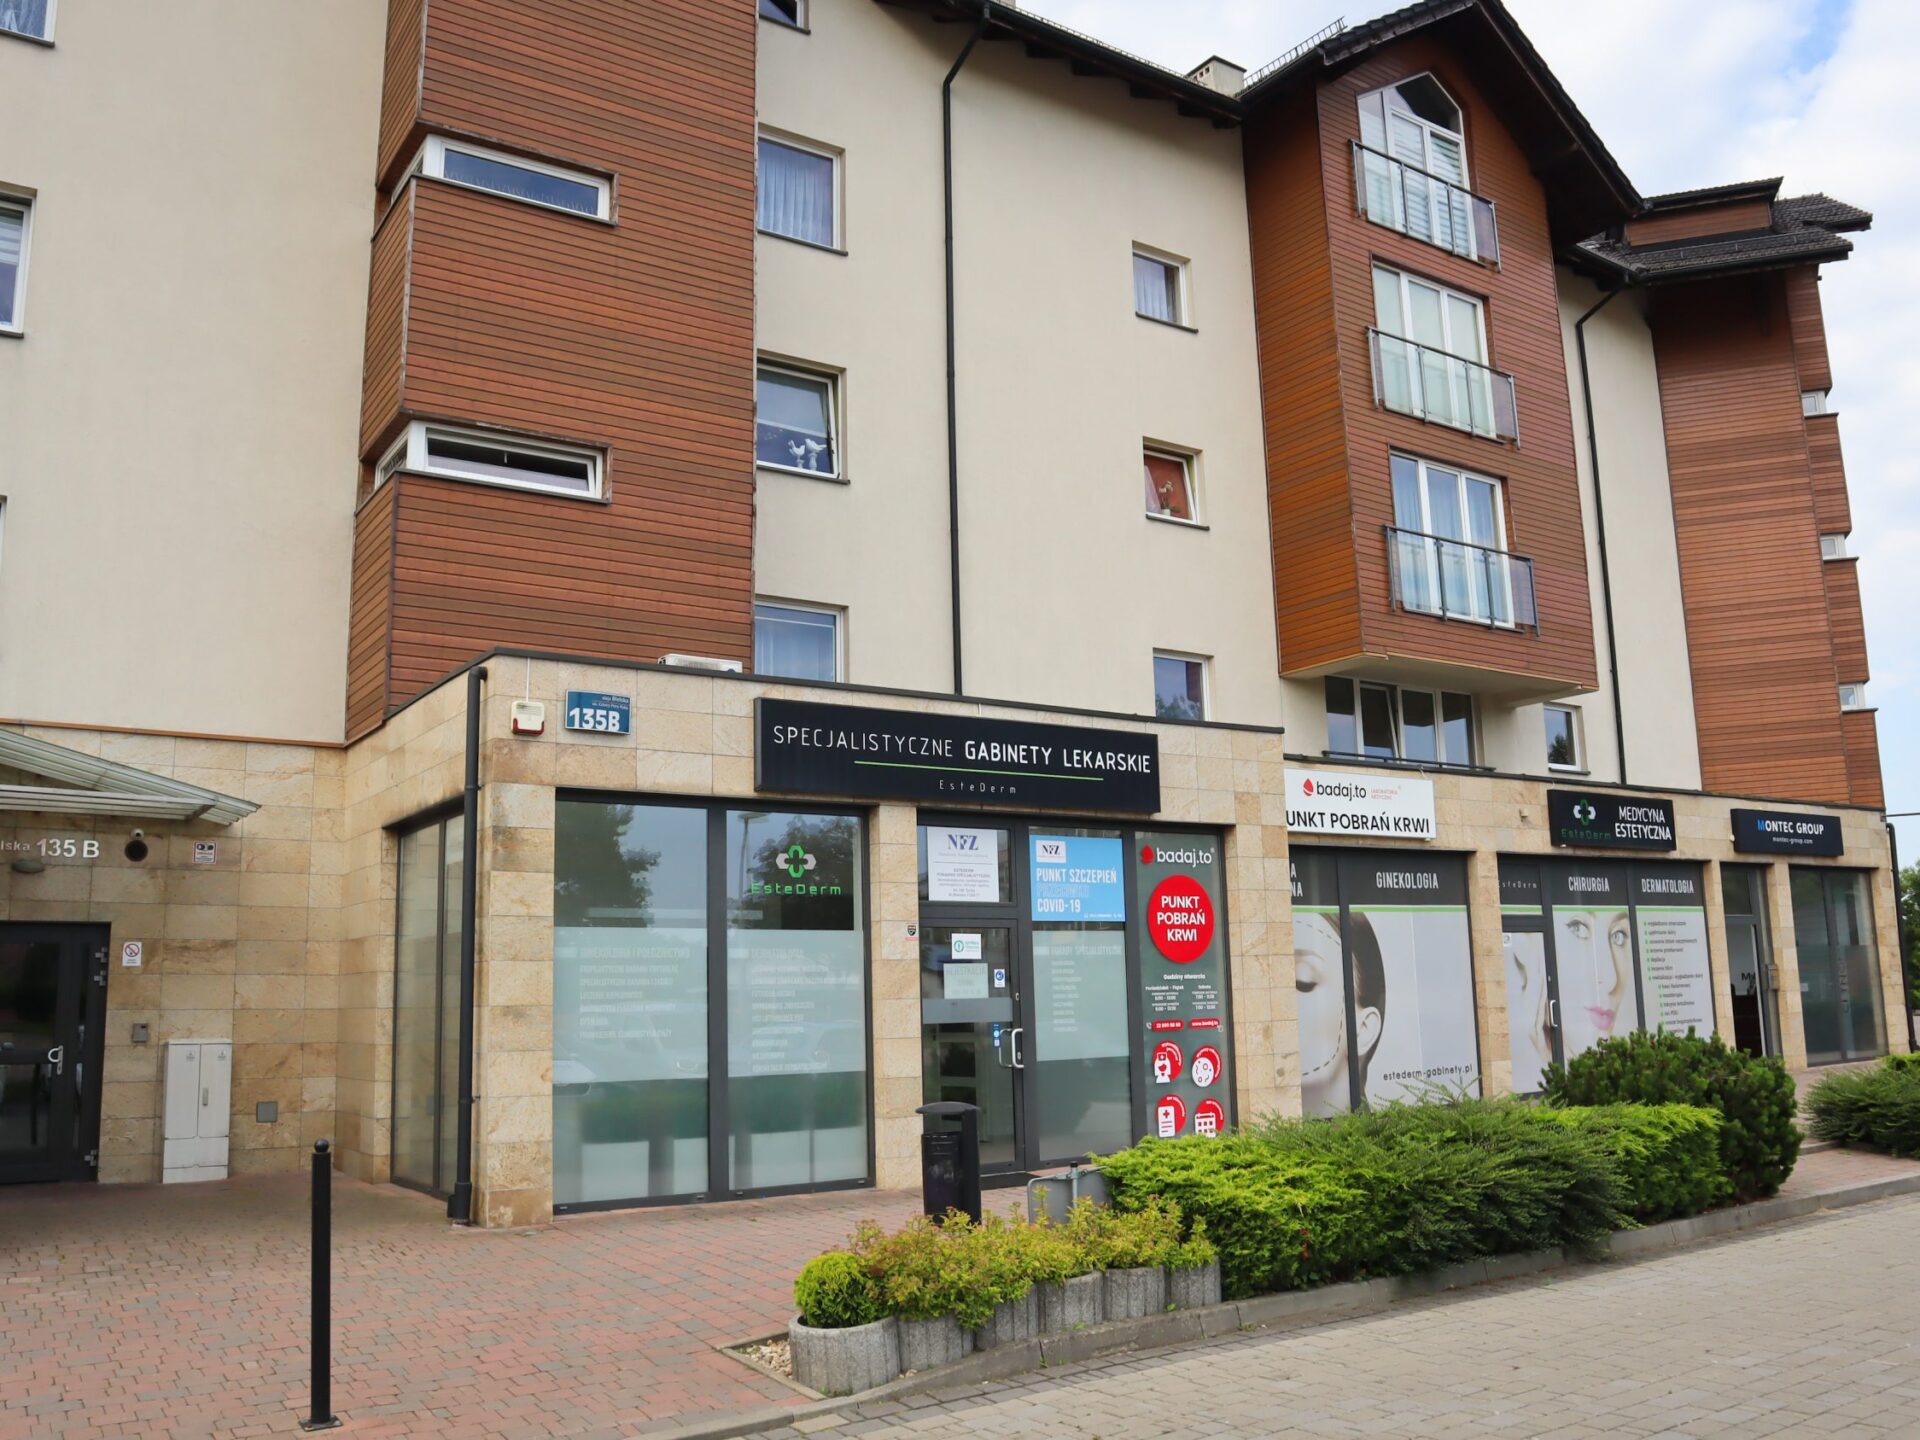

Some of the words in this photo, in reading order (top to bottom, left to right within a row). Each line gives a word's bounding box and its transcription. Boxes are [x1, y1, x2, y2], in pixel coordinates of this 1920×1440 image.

[569, 707, 620, 731] 135B
[773, 725, 953, 757] SPECJALISTYCZNE
[965, 740, 1052, 765] GABINETY
[1063, 748, 1151, 773] LEKARSKIE
[939, 779, 1017, 794] EsteDerm
[1316, 778, 1367, 801] badaj.to
[1286, 810, 1326, 828] UNKT
[1330, 811, 1390, 831] POBRAŃ
[1393, 816, 1430, 833] KRWI
[1618, 806, 1666, 823] MEDYCYNA
[1614, 823, 1672, 840] ESTETYCZNA
[1757, 819, 1794, 833] MONTEC
[1796, 822, 1824, 835] GROUP
[36, 838, 77, 858] 135
[82, 839, 100, 858] B
[947, 833, 979, 851] NFZ
[1042, 844, 1061, 855] NFZ
[1156, 847, 1212, 868] badaj.to
[1036, 867, 1067, 883] PUNKT
[1069, 867, 1117, 885] SZCZEPIEŃ
[1375, 871, 1440, 889] GINEKOLOGIA
[1568, 876, 1610, 893] CHIRURGIA
[751, 882, 841, 895] EsteDerm
[1641, 878, 1695, 894] DERMATOLOGIA
[1037, 898, 1081, 913] COVID-19
[1161, 895, 1200, 909] PUNKT
[1156, 909, 1206, 925] POBRAŃ
[1167, 928, 1198, 942] KRWI
[1383, 1064, 1473, 1081] estederm-gabinety.pl
